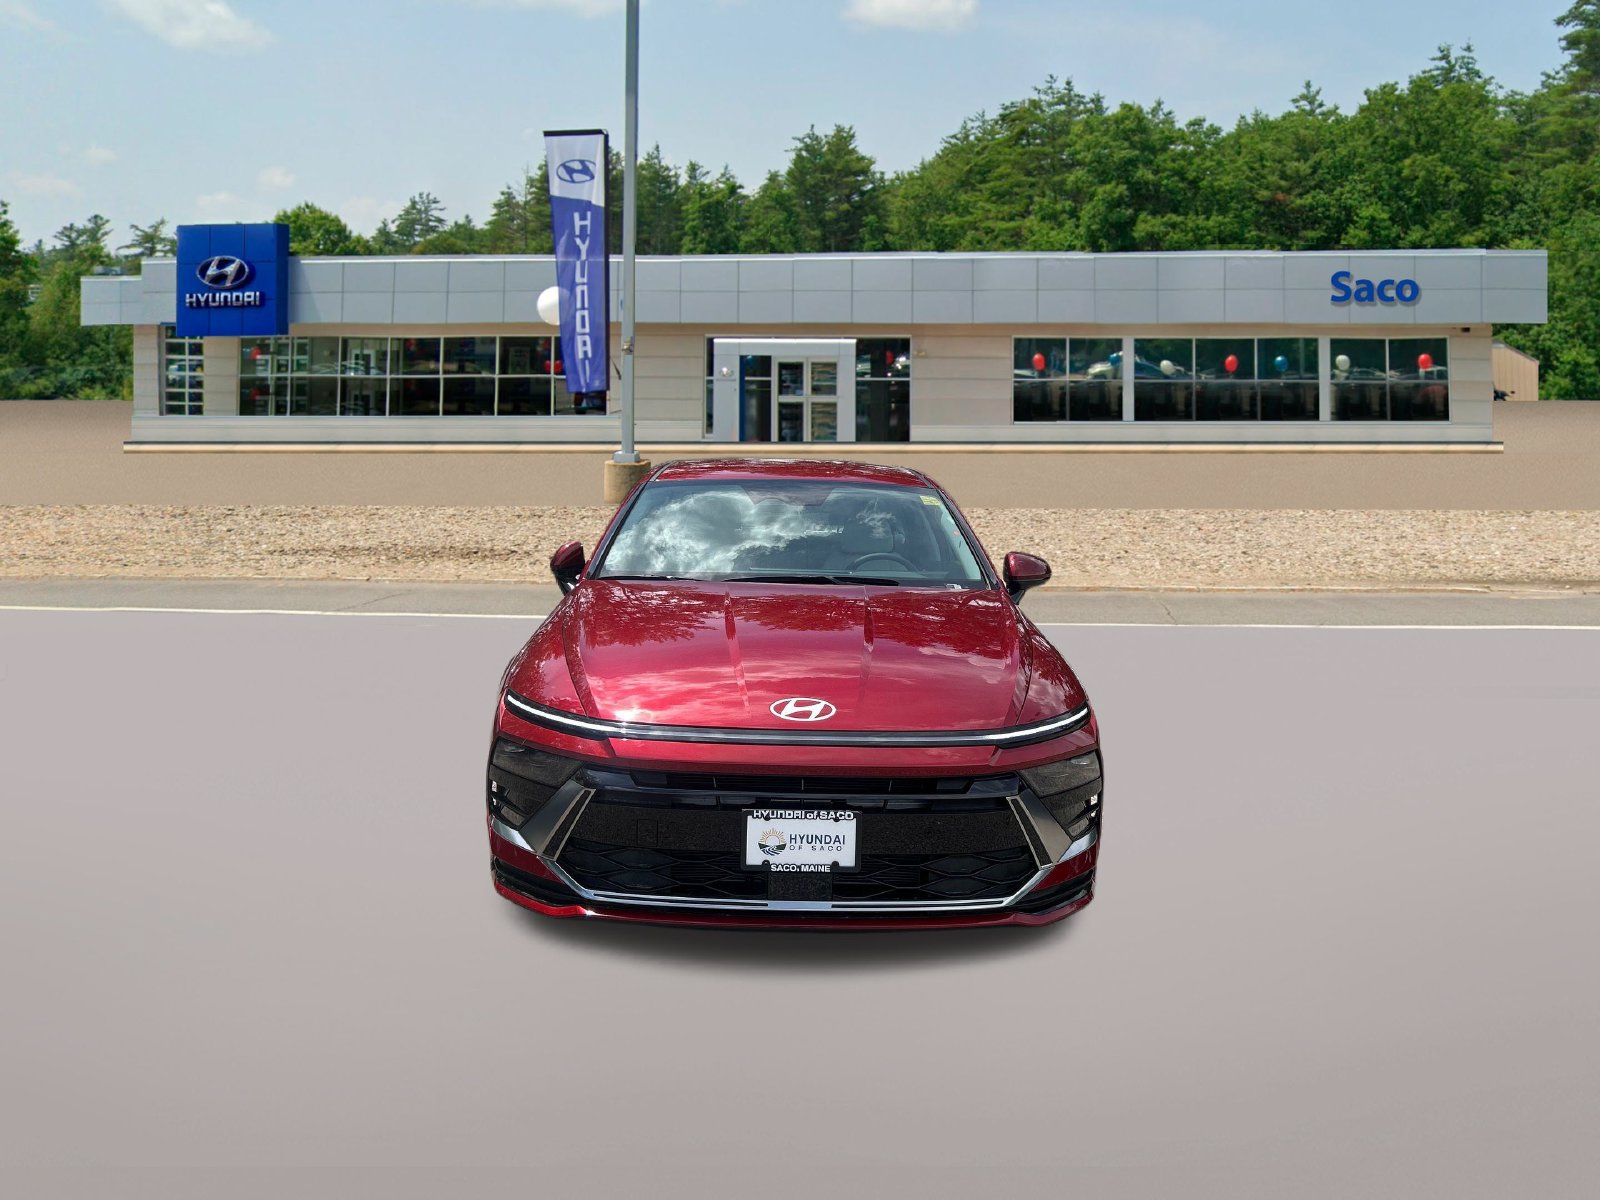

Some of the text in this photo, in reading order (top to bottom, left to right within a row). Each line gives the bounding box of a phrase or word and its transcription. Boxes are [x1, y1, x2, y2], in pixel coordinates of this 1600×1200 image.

[1330, 270, 1420, 303] Saco
[185, 291, 260, 307] HYUNDAI
[573, 211, 592, 383] HYUNDAI
[753, 810, 805, 819] HYUNDAI
[819, 811, 854, 820] SACO
[789, 834, 845, 845] HYUNDAI
[801, 864, 831, 873] MAINE
